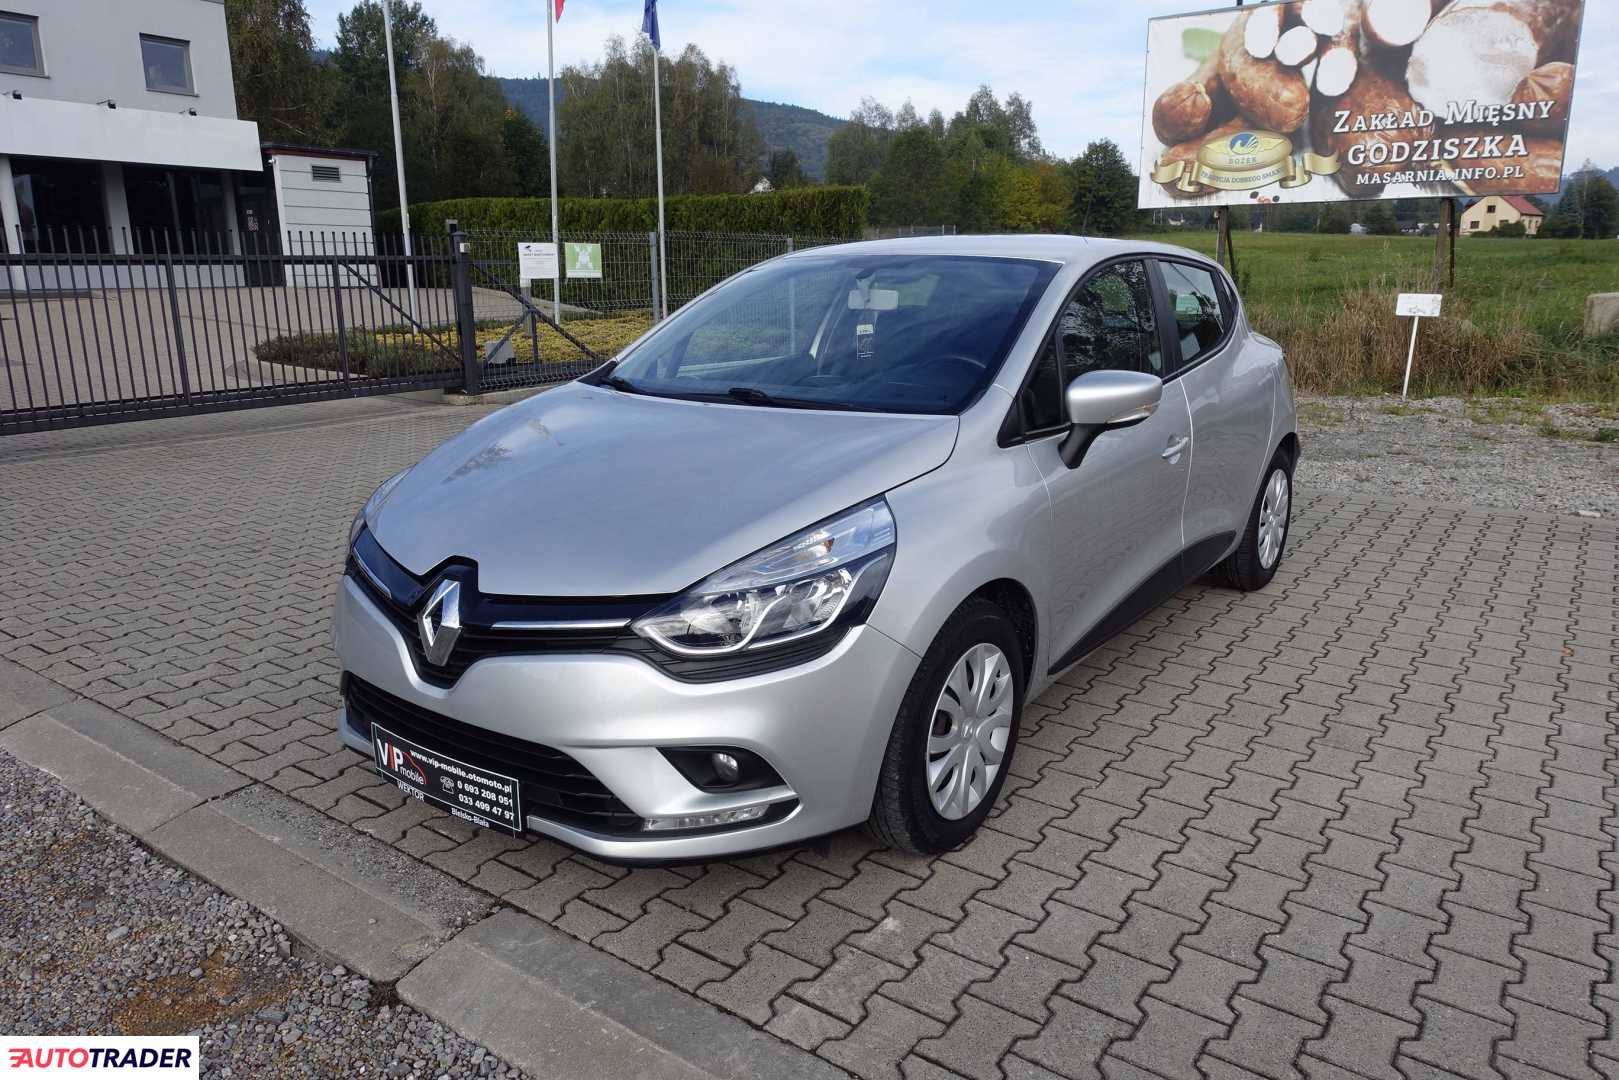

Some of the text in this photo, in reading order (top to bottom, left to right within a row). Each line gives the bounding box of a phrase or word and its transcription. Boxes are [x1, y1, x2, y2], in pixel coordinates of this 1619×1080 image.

[1333, 99, 1555, 133] ZAKŁAD MIĘSNY
[1347, 134, 1528, 165] GODZISZKA
[1356, 165, 1525, 185] MASARNIA.INFO.PL
[376, 738, 404, 772] VIP
[400, 766, 425, 785] mobile
[409, 749, 513, 793] www.vip-mobile.otomoto.pl
[397, 780, 425, 802] WEKTOR
[457, 780, 513, 807] 0 693 208 051
[458, 793, 515, 820] 033 499 47 97
